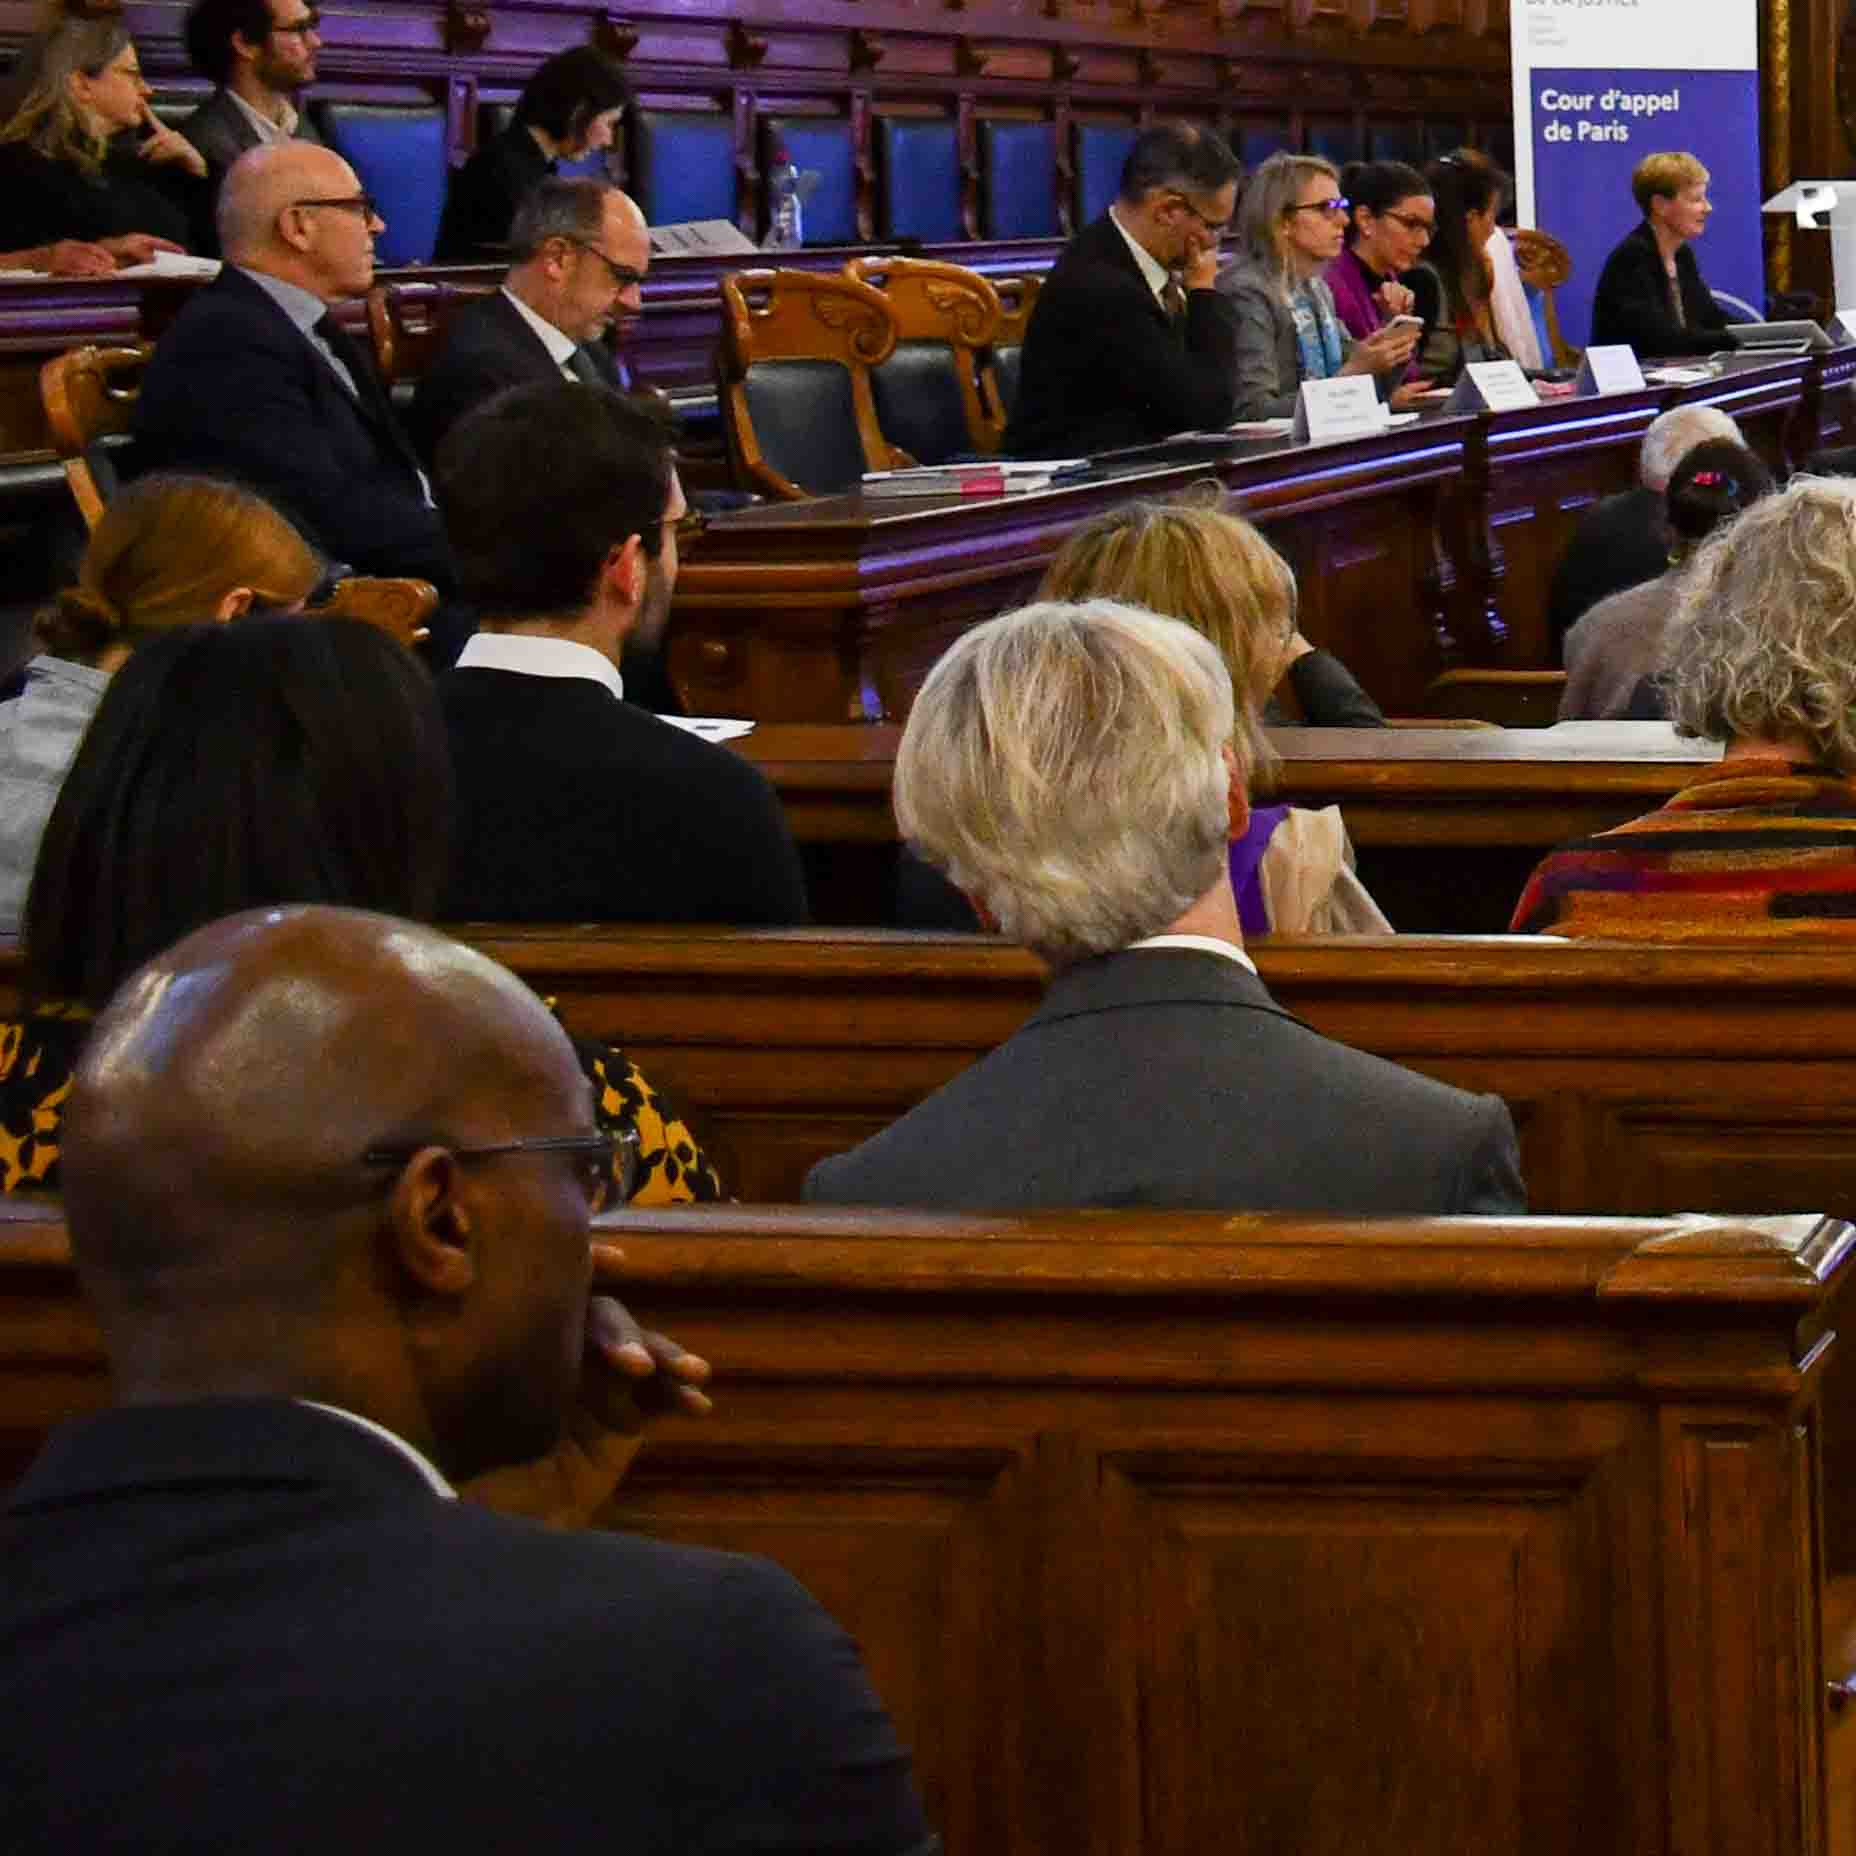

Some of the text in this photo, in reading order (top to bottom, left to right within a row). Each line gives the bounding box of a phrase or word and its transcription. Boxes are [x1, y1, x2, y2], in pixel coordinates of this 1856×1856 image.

[1540, 88, 1680, 117] Cour d'appel
[1543, 119, 1630, 142] de Paris
